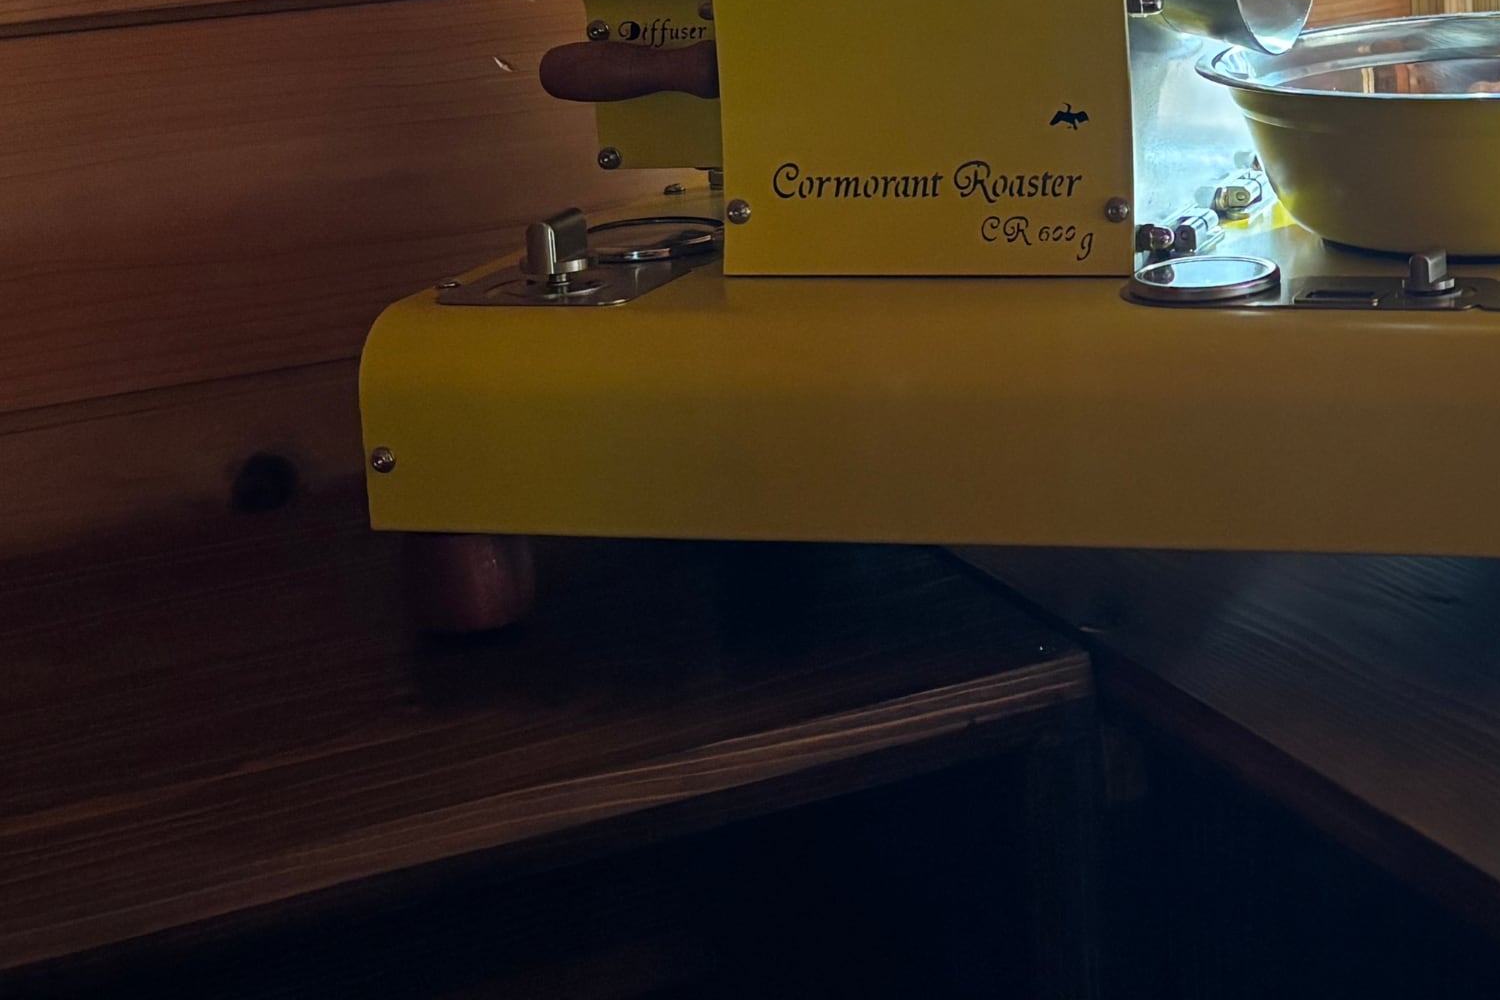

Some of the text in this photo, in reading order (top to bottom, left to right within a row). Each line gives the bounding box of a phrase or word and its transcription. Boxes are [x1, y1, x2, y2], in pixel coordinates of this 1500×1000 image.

[617, 18, 707, 48] Diffuser
[772, 160, 1083, 203] Cormorant Roaster
